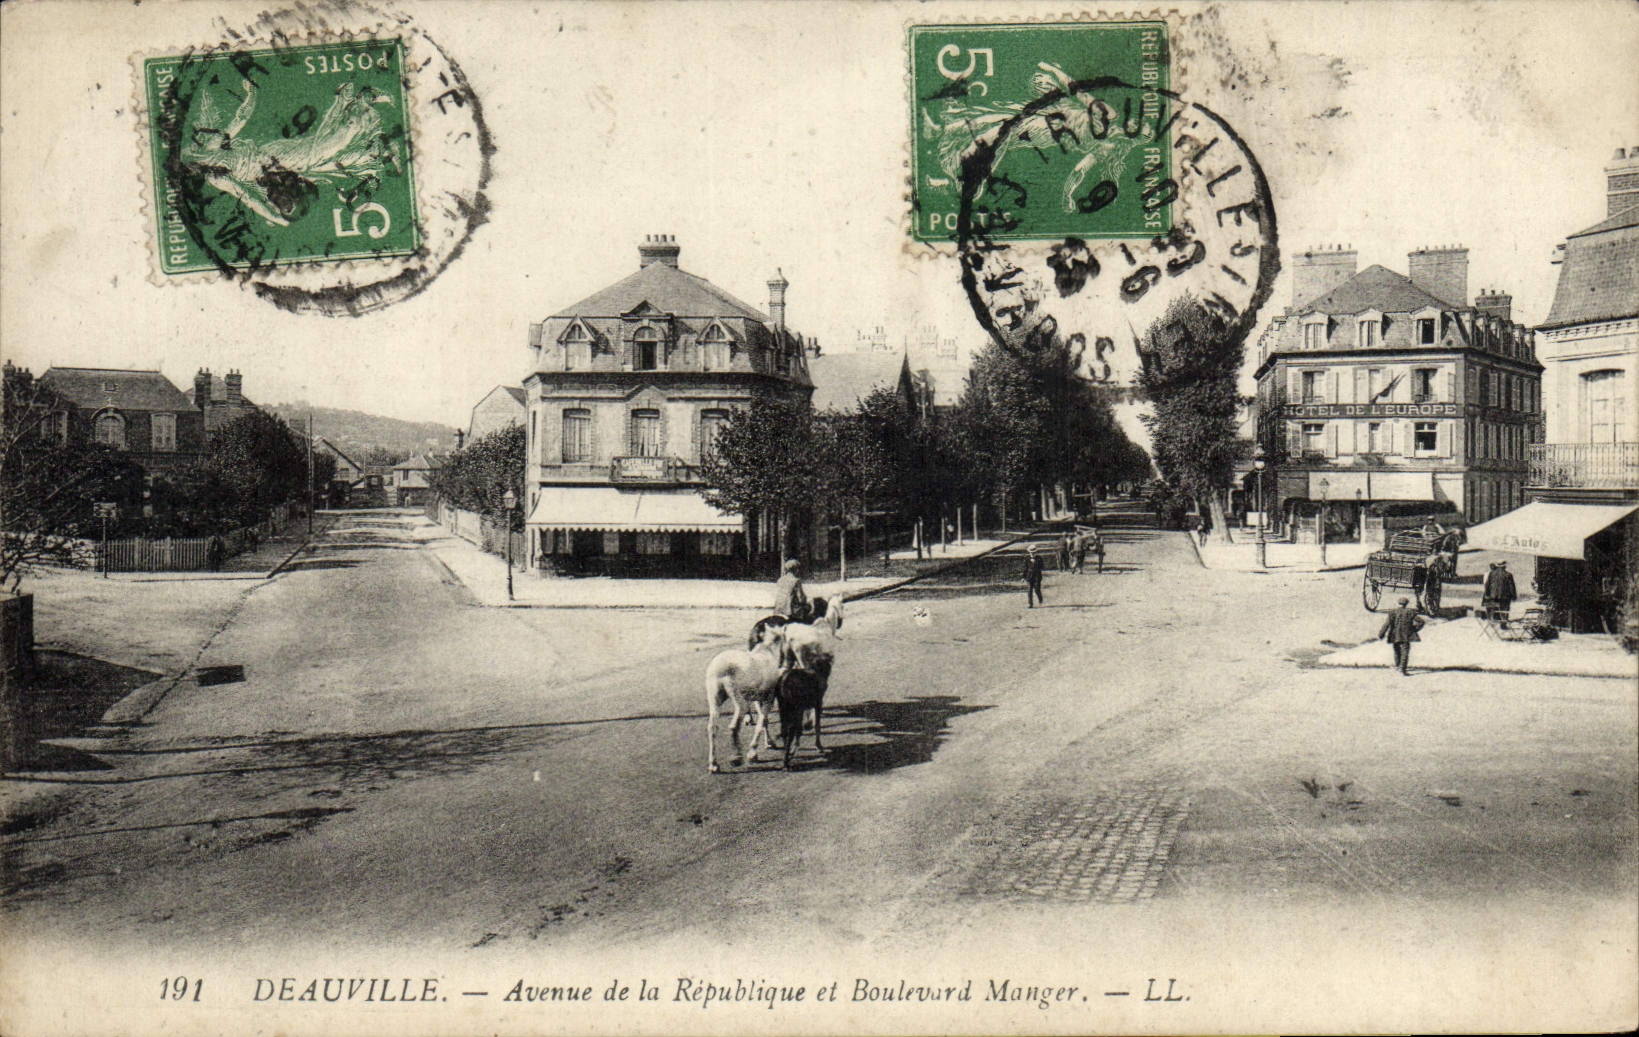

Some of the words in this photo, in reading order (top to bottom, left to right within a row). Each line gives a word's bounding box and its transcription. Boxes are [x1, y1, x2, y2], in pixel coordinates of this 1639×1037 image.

[304, 50, 388, 75] POSTES
[930, 212, 1013, 231] POTS
[1346, 406, 1366, 415] DE
[1372, 404, 1458, 416] L'EUROPE
